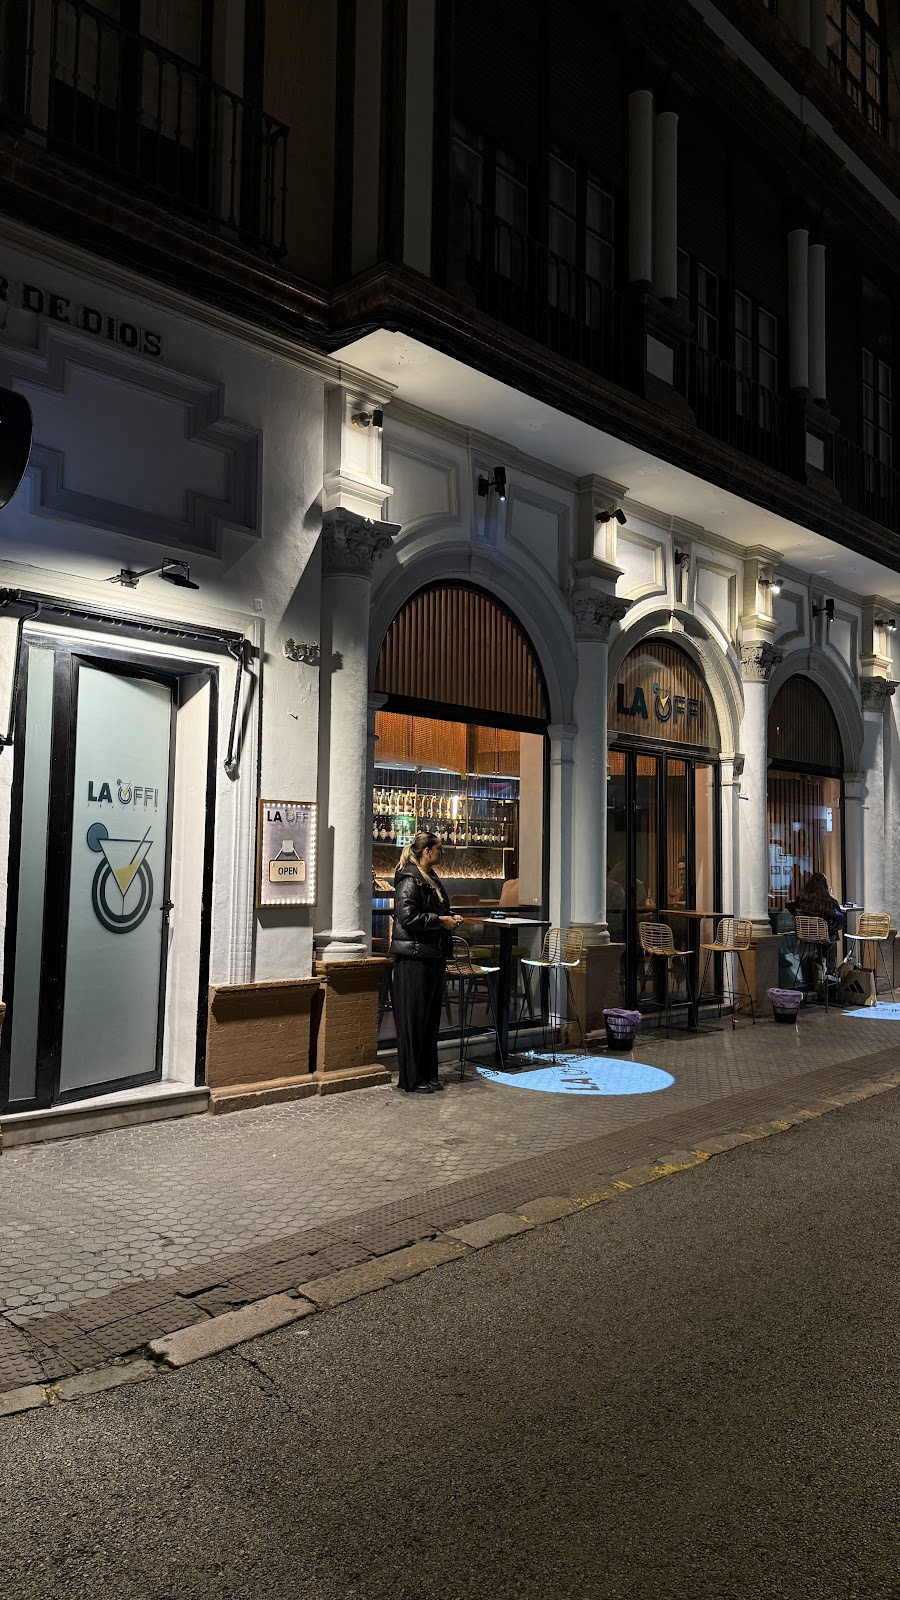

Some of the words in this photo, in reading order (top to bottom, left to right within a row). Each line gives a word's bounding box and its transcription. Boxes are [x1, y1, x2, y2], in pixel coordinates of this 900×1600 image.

[22, 284, 70, 324] DE
[82, 307, 161, 356] DIOS
[617, 682, 648, 720] LA
[88, 780, 113, 803] LA
[267, 810, 283, 823] LA
[285, 810, 311, 824] OFF
[278, 866, 298, 876] OPEN
